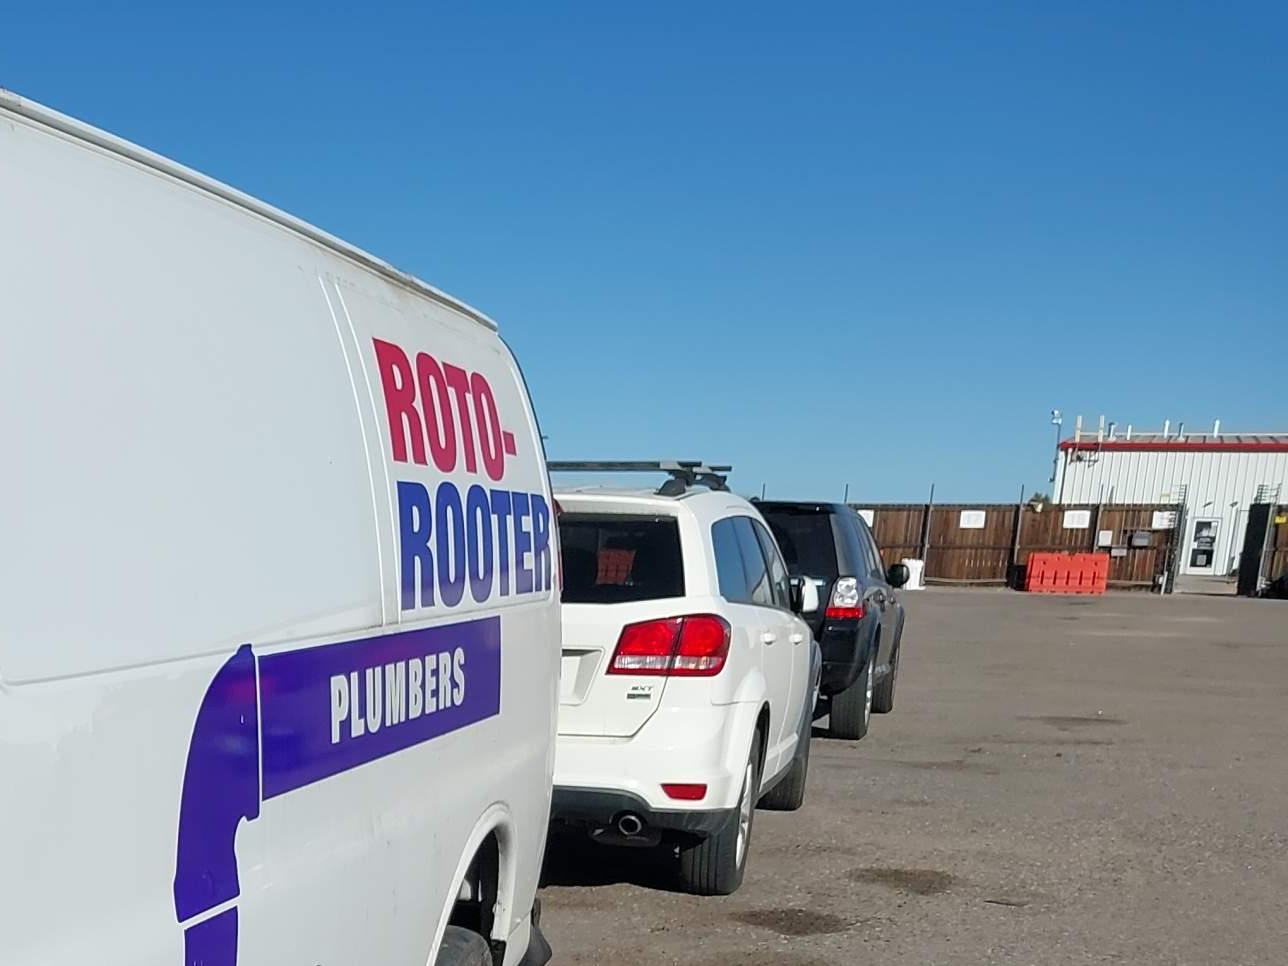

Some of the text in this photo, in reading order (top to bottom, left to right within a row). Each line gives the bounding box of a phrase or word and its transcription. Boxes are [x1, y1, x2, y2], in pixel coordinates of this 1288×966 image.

[373, 338, 516, 482] ROTO-
[396, 480, 552, 611] ROOTER
[329, 646, 466, 744] PLUMBERS
